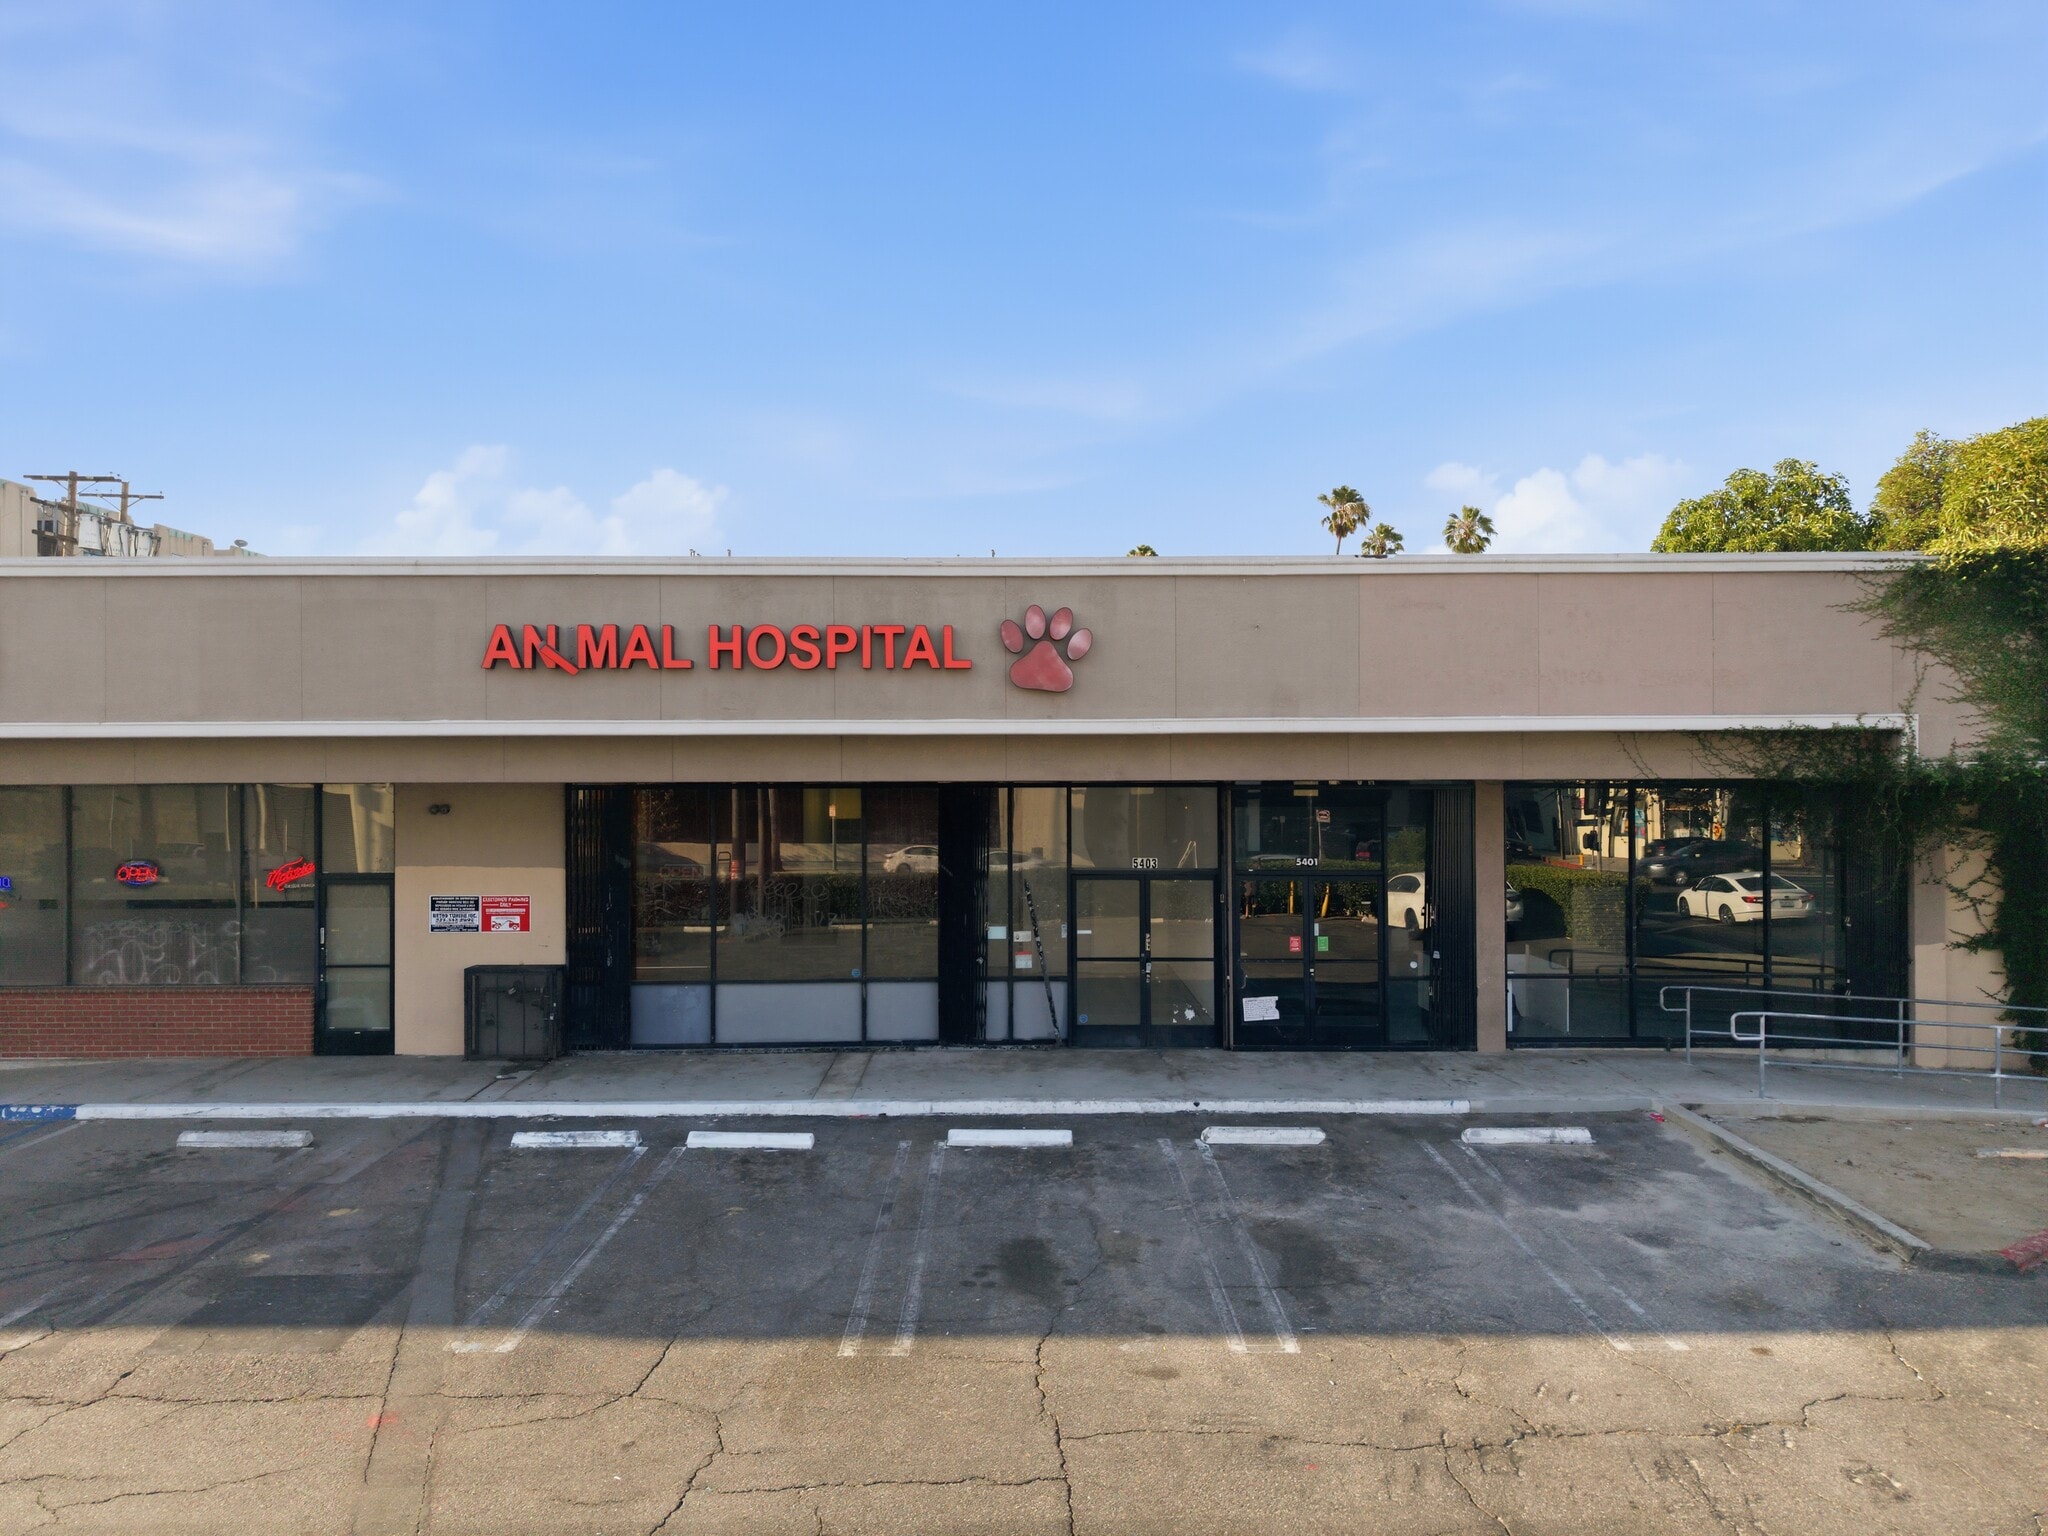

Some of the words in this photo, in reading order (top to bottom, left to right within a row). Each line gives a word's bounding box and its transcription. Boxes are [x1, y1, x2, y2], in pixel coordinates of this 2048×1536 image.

[708, 624, 973, 671] HOSPITAL
[1133, 858, 1157, 868] 5403
[1296, 858, 1318, 866] 5401
[117, 866, 159, 882] OPEN
